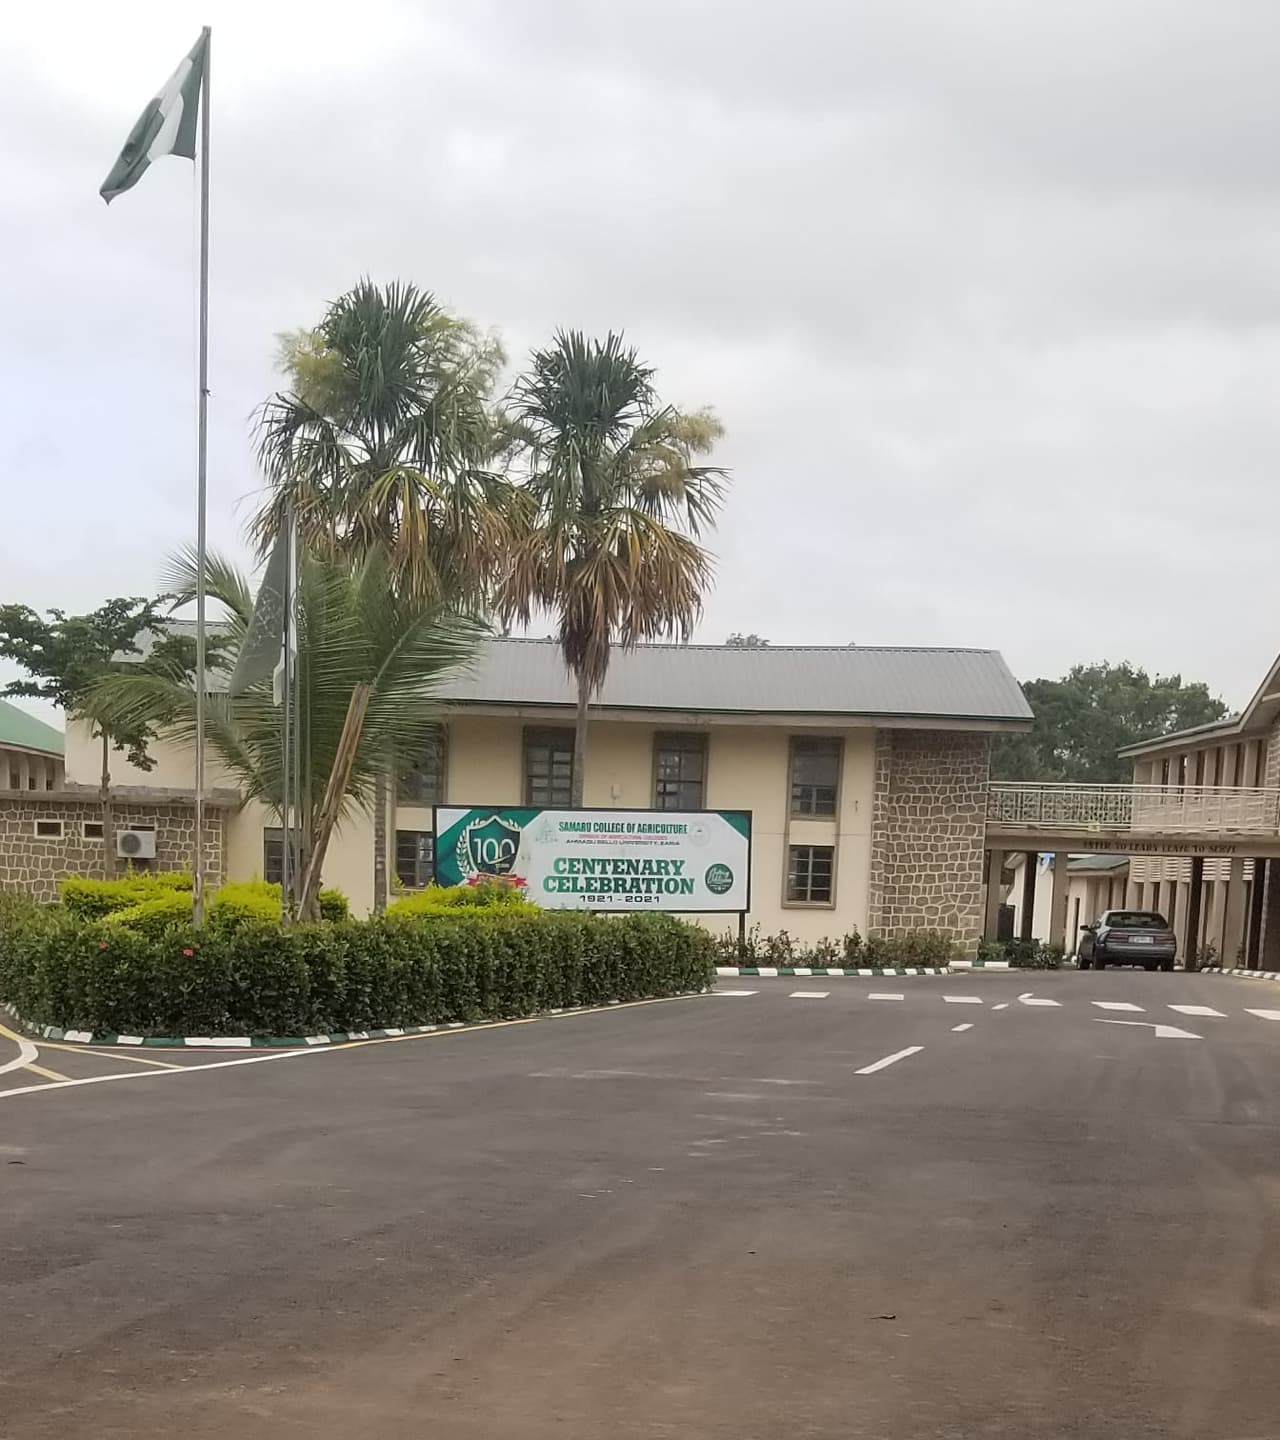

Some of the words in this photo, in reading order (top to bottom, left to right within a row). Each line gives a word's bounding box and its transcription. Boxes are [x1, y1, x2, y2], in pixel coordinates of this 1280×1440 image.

[558, 821, 591, 833] SAMARU
[593, 822, 626, 834] COLLEGE
[626, 823, 636, 834] OF
[637, 823, 688, 835] AGRICULTURE
[473, 838, 515, 865] 100
[553, 858, 686, 876] CENTENARY
[543, 876, 695, 895] CELEBRATION
[579, 895, 613, 903] 1921
